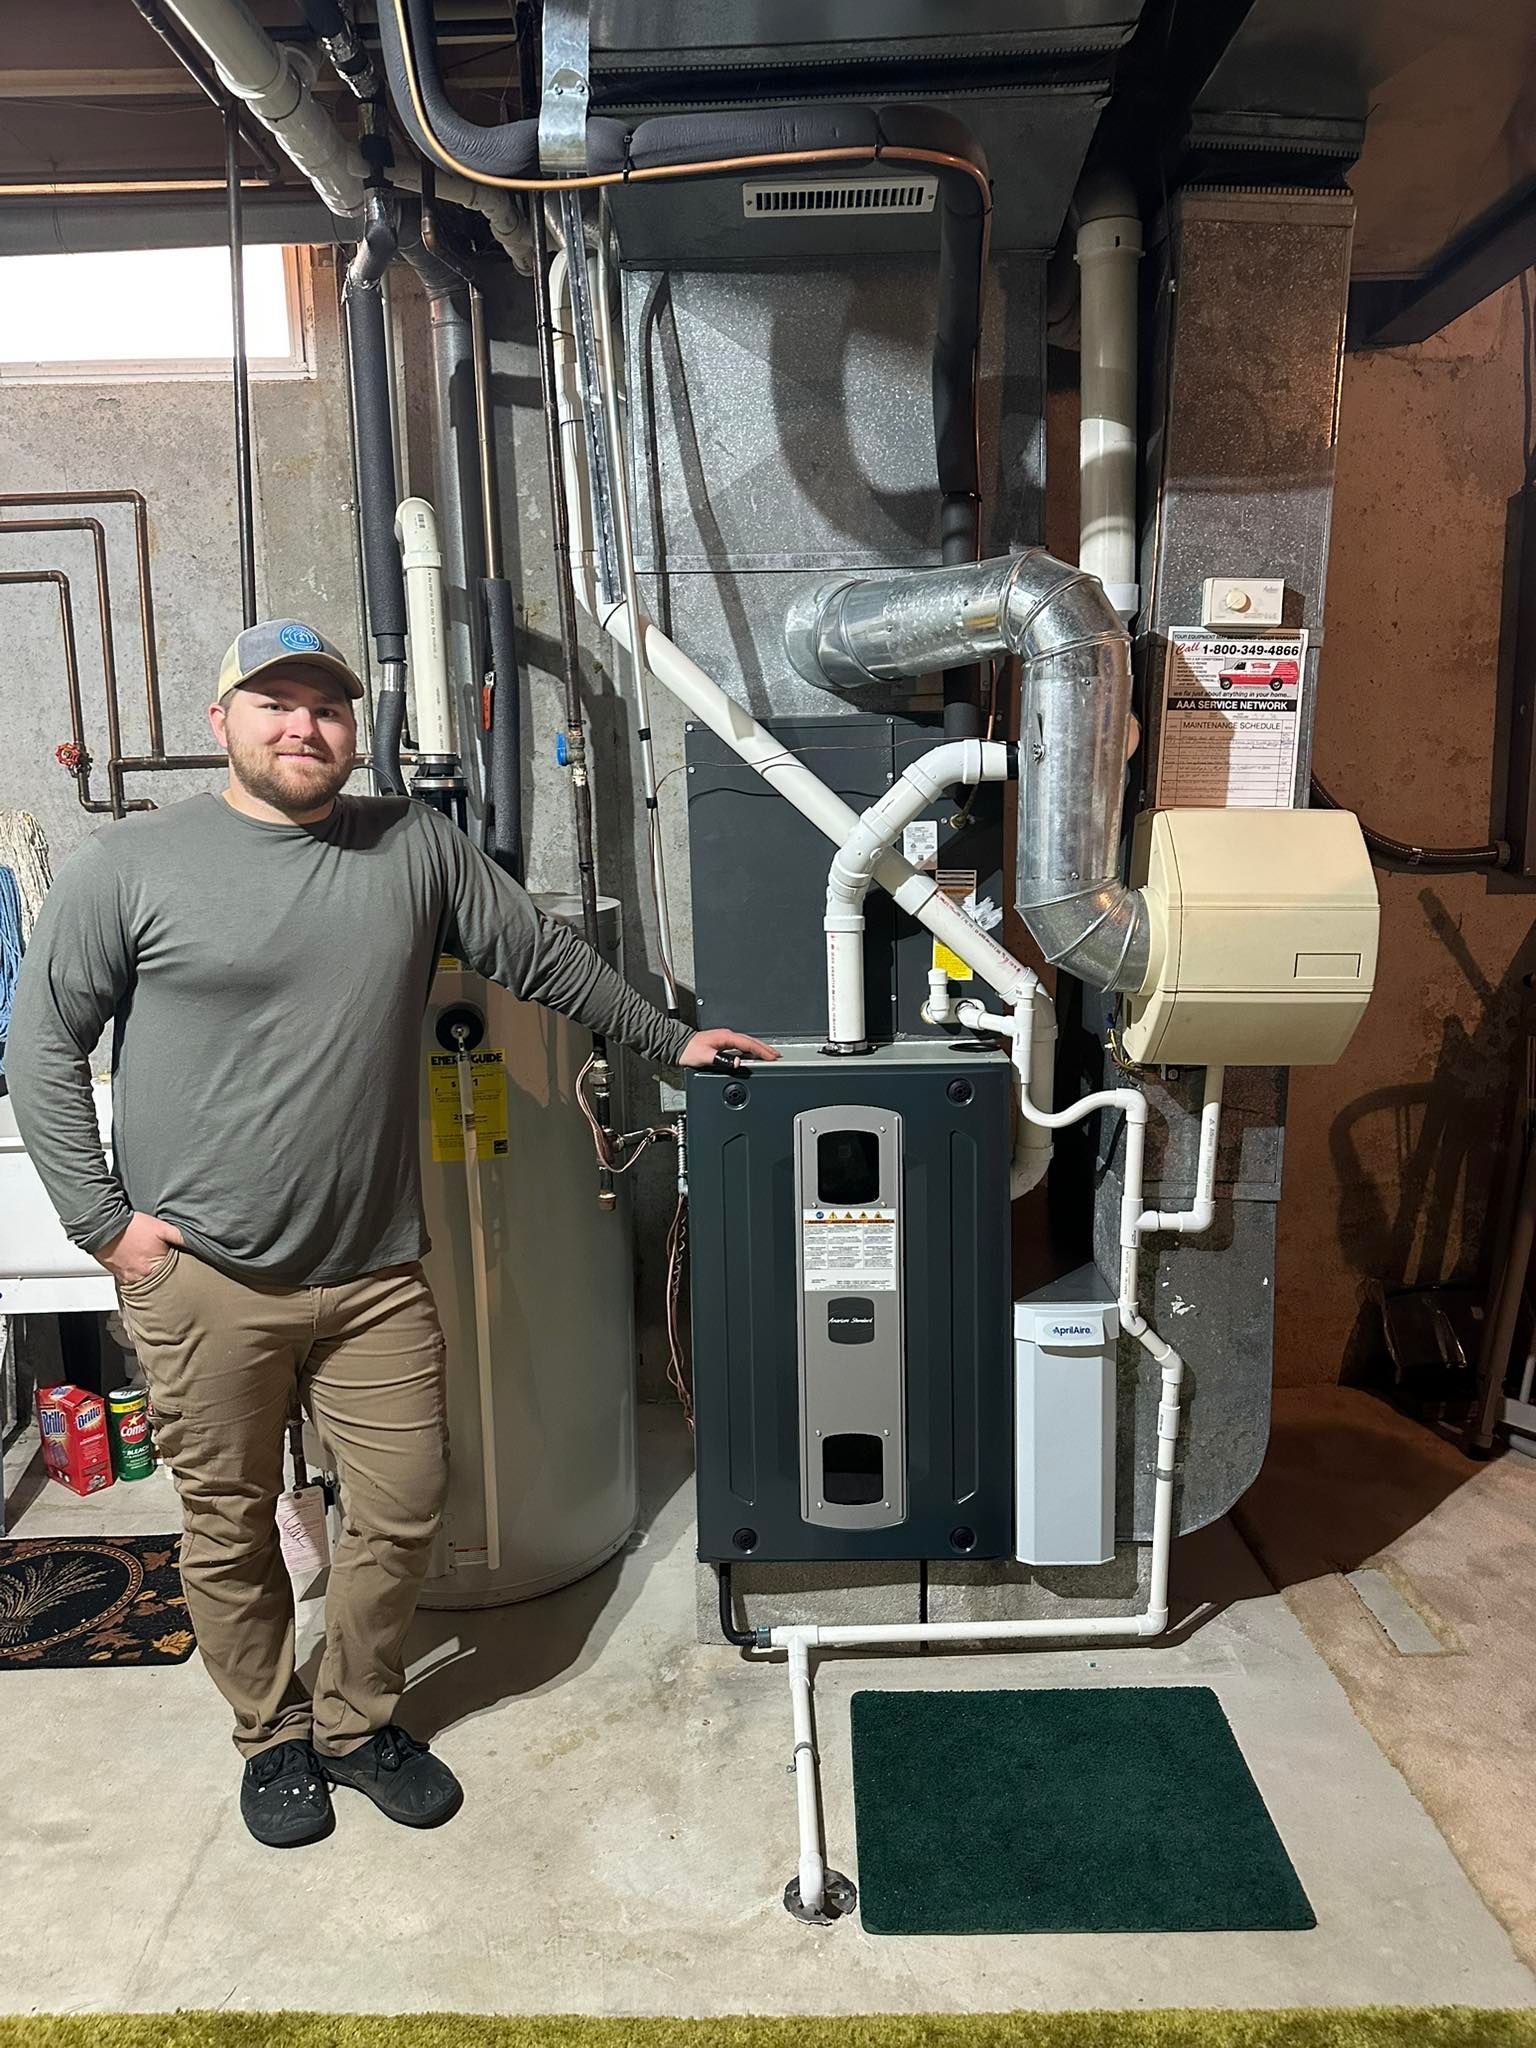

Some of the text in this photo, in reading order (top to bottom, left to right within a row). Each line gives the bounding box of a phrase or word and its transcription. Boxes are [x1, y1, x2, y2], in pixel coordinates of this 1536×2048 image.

[1175, 642, 1299, 656] Call 1-800-349-4866
[1176, 700, 1288, 710] AAA SERVICE NETWORK
[1183, 721, 1238, 729] MAINTENANCE
[1053, 1326, 1091, 1336] AprilAire
[78, 1406, 101, 1428] Brillo
[42, 1411, 66, 1436] Brillo
